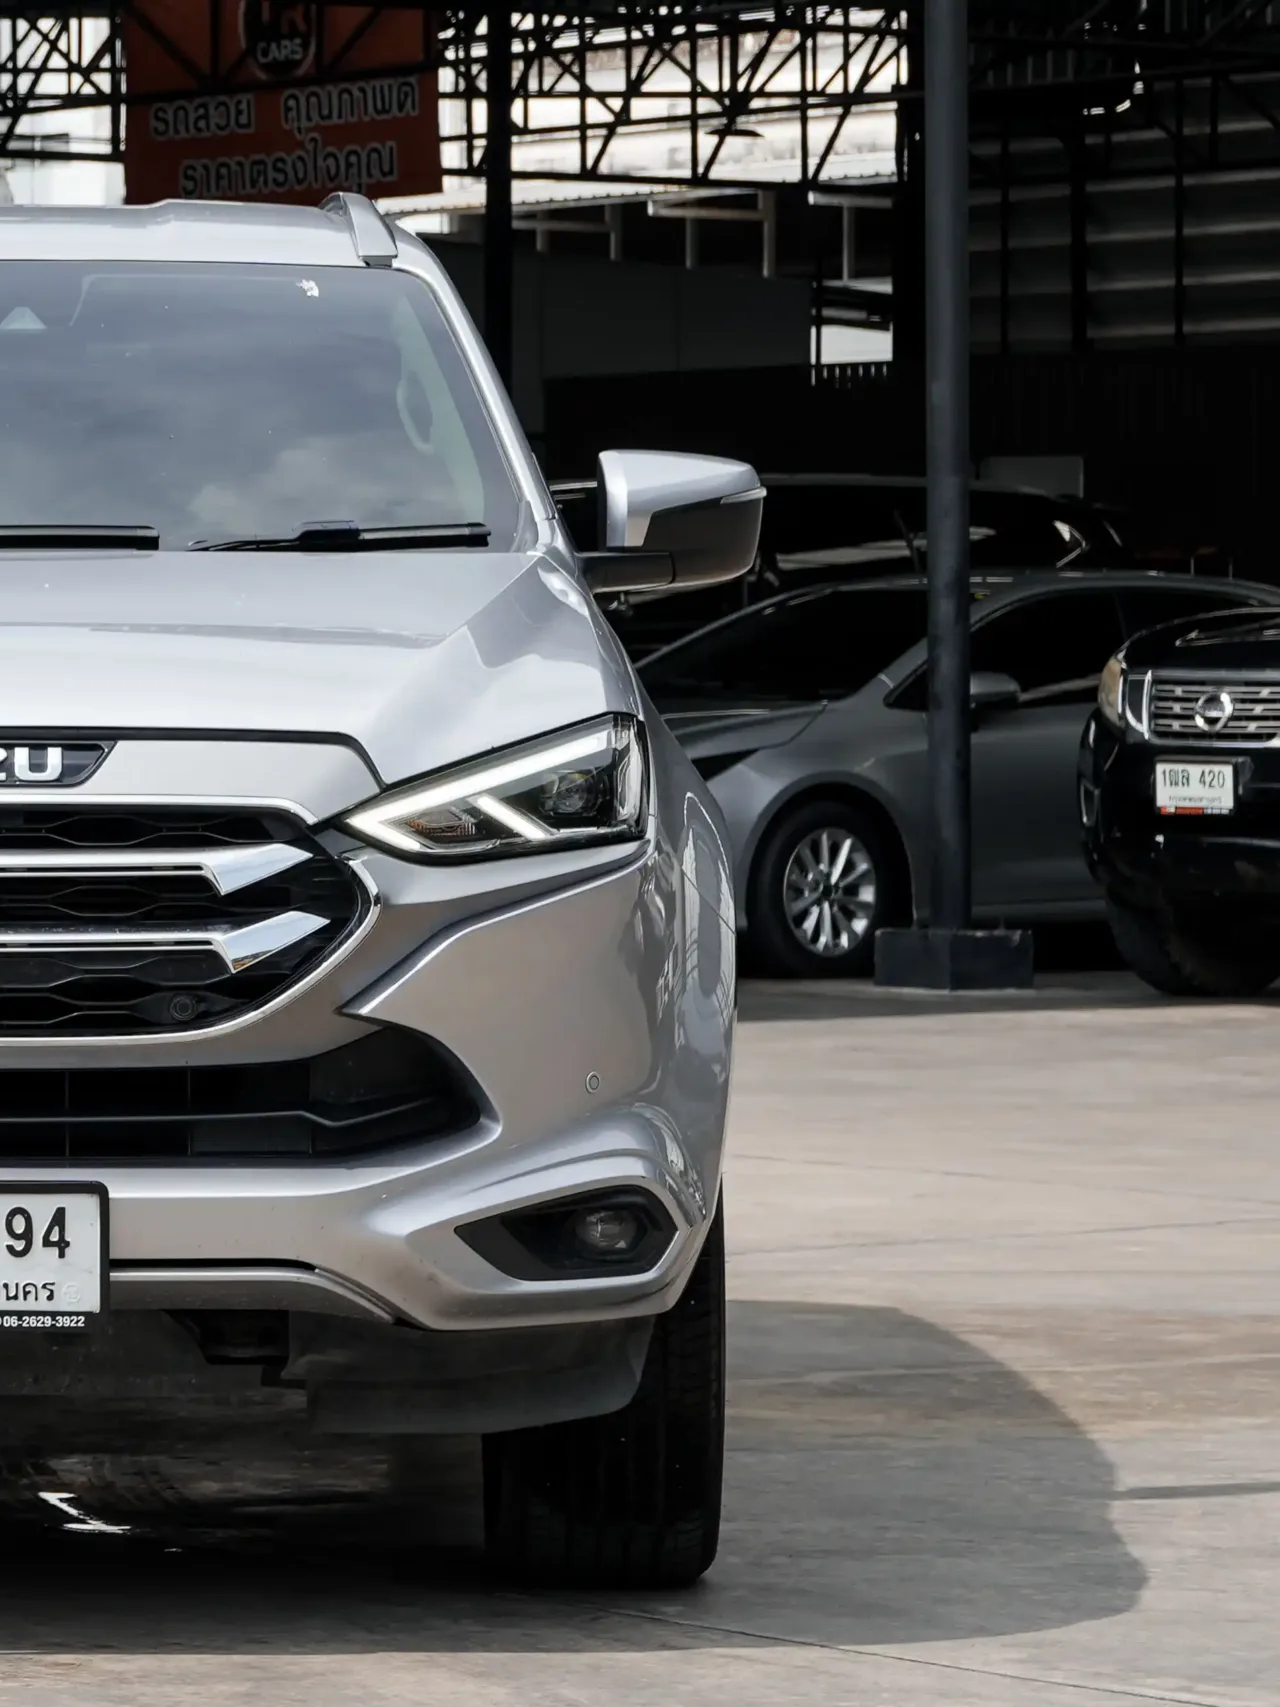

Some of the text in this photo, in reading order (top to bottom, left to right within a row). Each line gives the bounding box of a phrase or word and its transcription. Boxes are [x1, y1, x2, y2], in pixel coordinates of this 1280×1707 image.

[256, 38, 304, 63] CARS
[150, 76, 419, 140] รถสวย คุณภาพด
[180, 135, 398, 196] ราคาตรงใจคุณ
[1199, 770, 1225, 788] 420
[2, 1315, 86, 1329] 06-2629-3922
